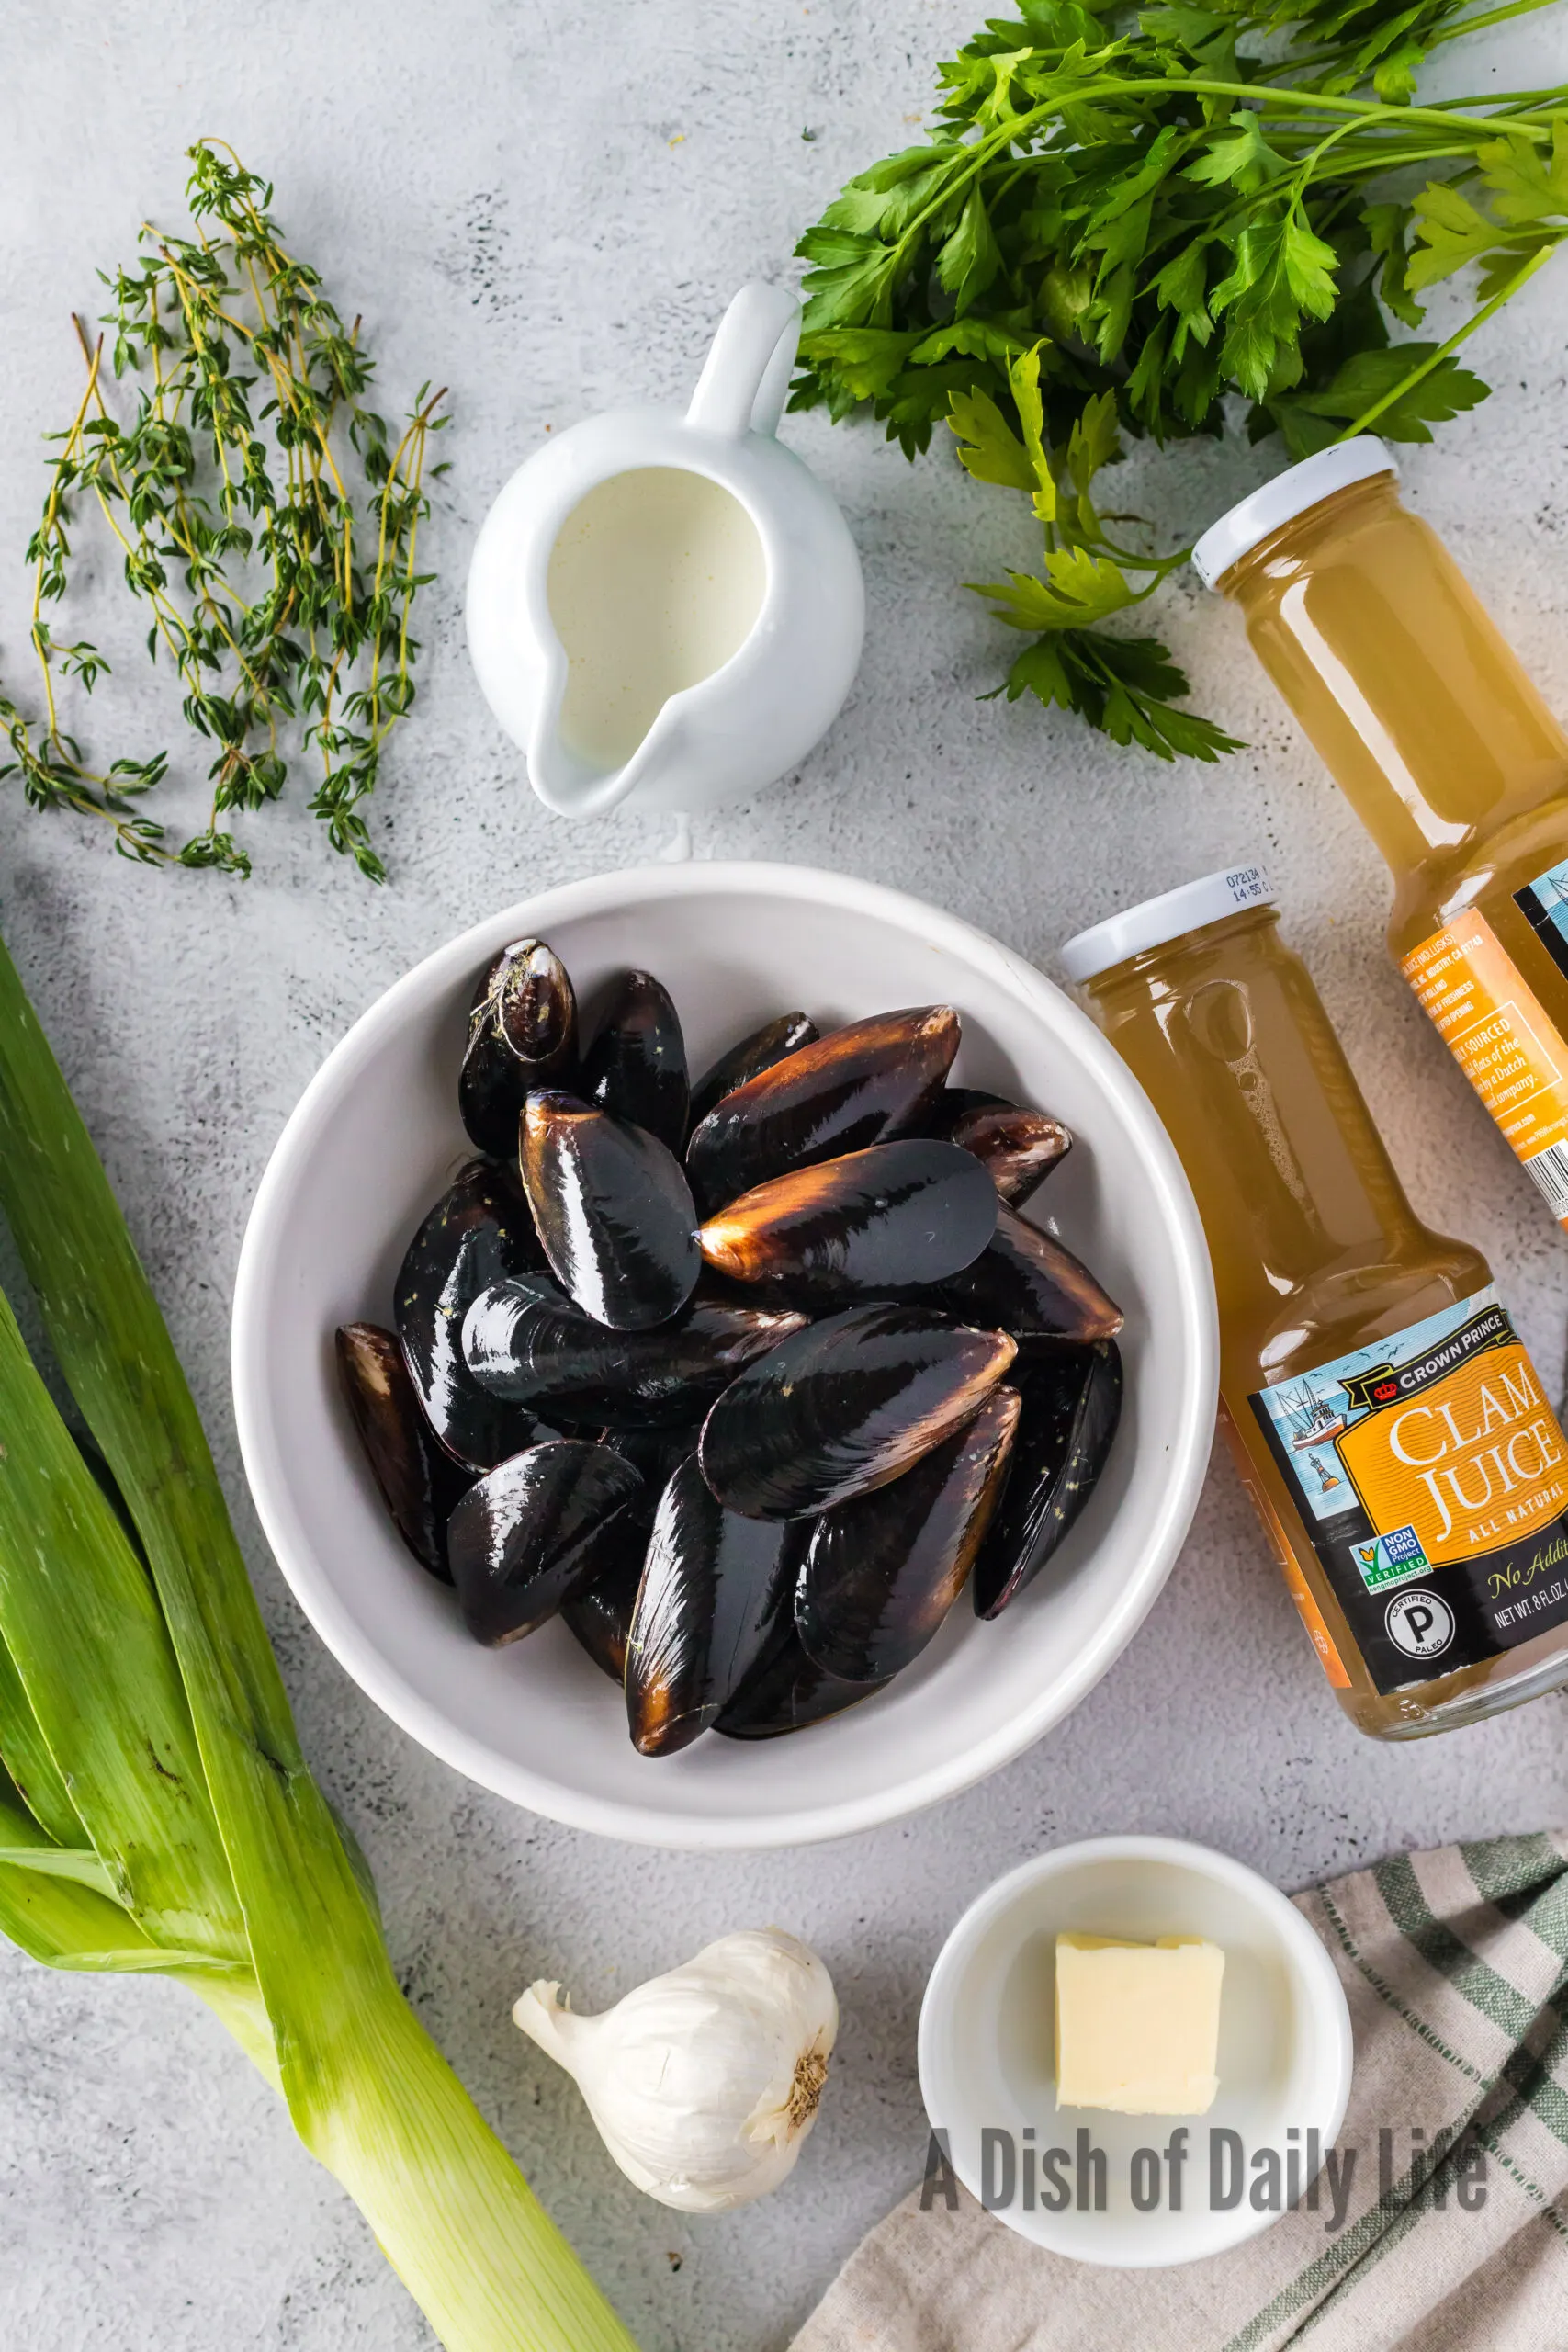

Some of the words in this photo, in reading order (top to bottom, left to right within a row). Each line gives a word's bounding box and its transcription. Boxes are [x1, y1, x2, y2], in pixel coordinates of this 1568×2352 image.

[1226, 868, 1260, 888] 072134
[1233, 883, 1262, 902] 14:55
[1451, 948, 1463, 961] CA
[1426, 978, 1448, 999] HOLLAND
[1441, 980, 1474, 1008] FRESHNESS
[1450, 1000, 1474, 1023] OPENING
[1465, 1018, 1511, 1056] SOURCED
[1473, 1056, 1493, 1076] flats
[1491, 1044, 1503, 1062] of
[1501, 1036, 1521, 1056] the
[1482, 1077, 1493, 1092] by
[1491, 1075, 1498, 1085] a
[1495, 1054, 1527, 1081] Dutch
[1496, 1073, 1540, 1103] company.
[1399, 1342, 1462, 1389] CROWN
[1461, 1314, 1503, 1351] PRINCE
[1389, 1362, 1540, 1466] CLAM
[1416, 1419, 1561, 1543] JUICE
[1469, 1520, 1501, 1544] ALL
[1506, 1482, 1564, 1524] NATURAL
[1384, 1529, 1413, 1547] NON
[1388, 1539, 1416, 1555] GMO
[1392, 1547, 1420, 1563] Project
[1368, 1557, 1425, 1583] VERIFIED
[1369, 1566, 1432, 1593] nongmoproject.org
[1487, 1562, 1521, 1599] No
[1392, 1595, 1432, 1618] CERTIFIED
[1494, 1606, 1516, 1629] NET
[1513, 1599, 1535, 1619] WT.
[1531, 1595, 1541, 1611] 8
[1404, 1605, 1434, 1644] P
[1416, 1638, 1443, 1653] PALEO
